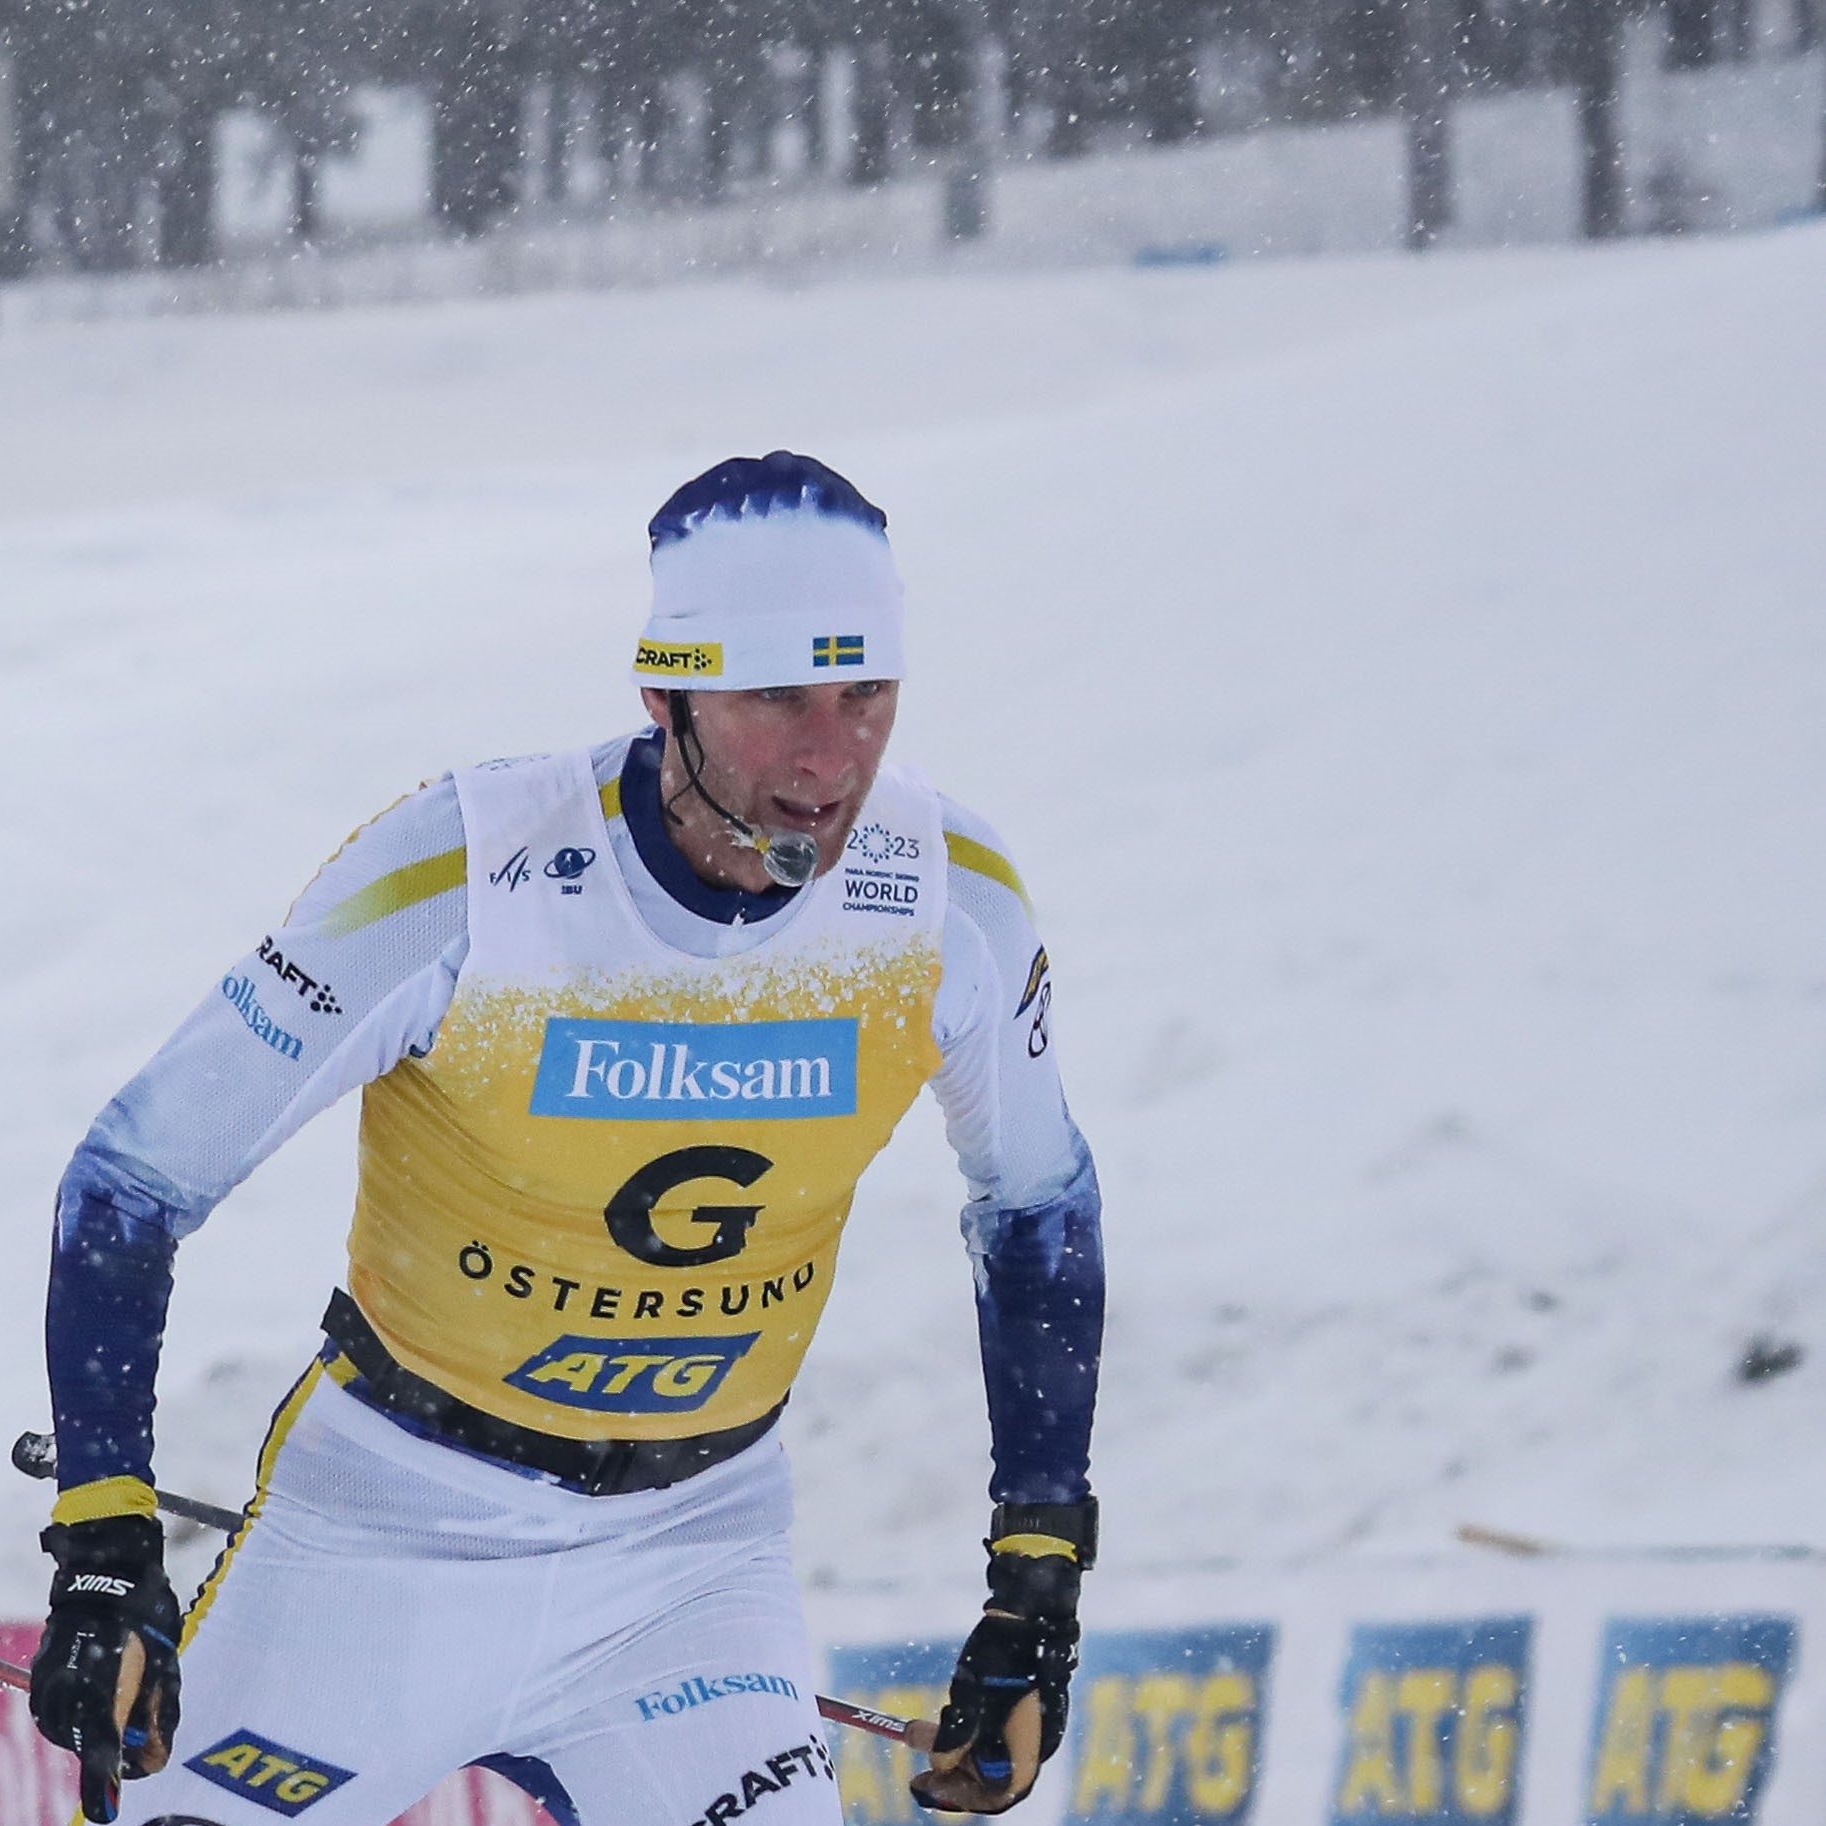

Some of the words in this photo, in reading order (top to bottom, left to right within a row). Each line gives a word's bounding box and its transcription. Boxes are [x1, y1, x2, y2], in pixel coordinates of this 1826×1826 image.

[636, 647, 692, 669] CRAFT
[845, 880, 919, 903] WORLD
[565, 1038, 833, 1102] Folksam
[604, 1144, 775, 1268] G
[459, 1240, 815, 1319] ÖSTERSUND
[526, 1353, 727, 1397] ATG
[634, 1671, 799, 1722] Folksam
[1076, 1671, 1257, 1817] ATG
[1340, 1664, 1520, 1816] ATG
[1591, 1660, 1777, 1815] ATG
[203, 1743, 330, 1803] ATG
